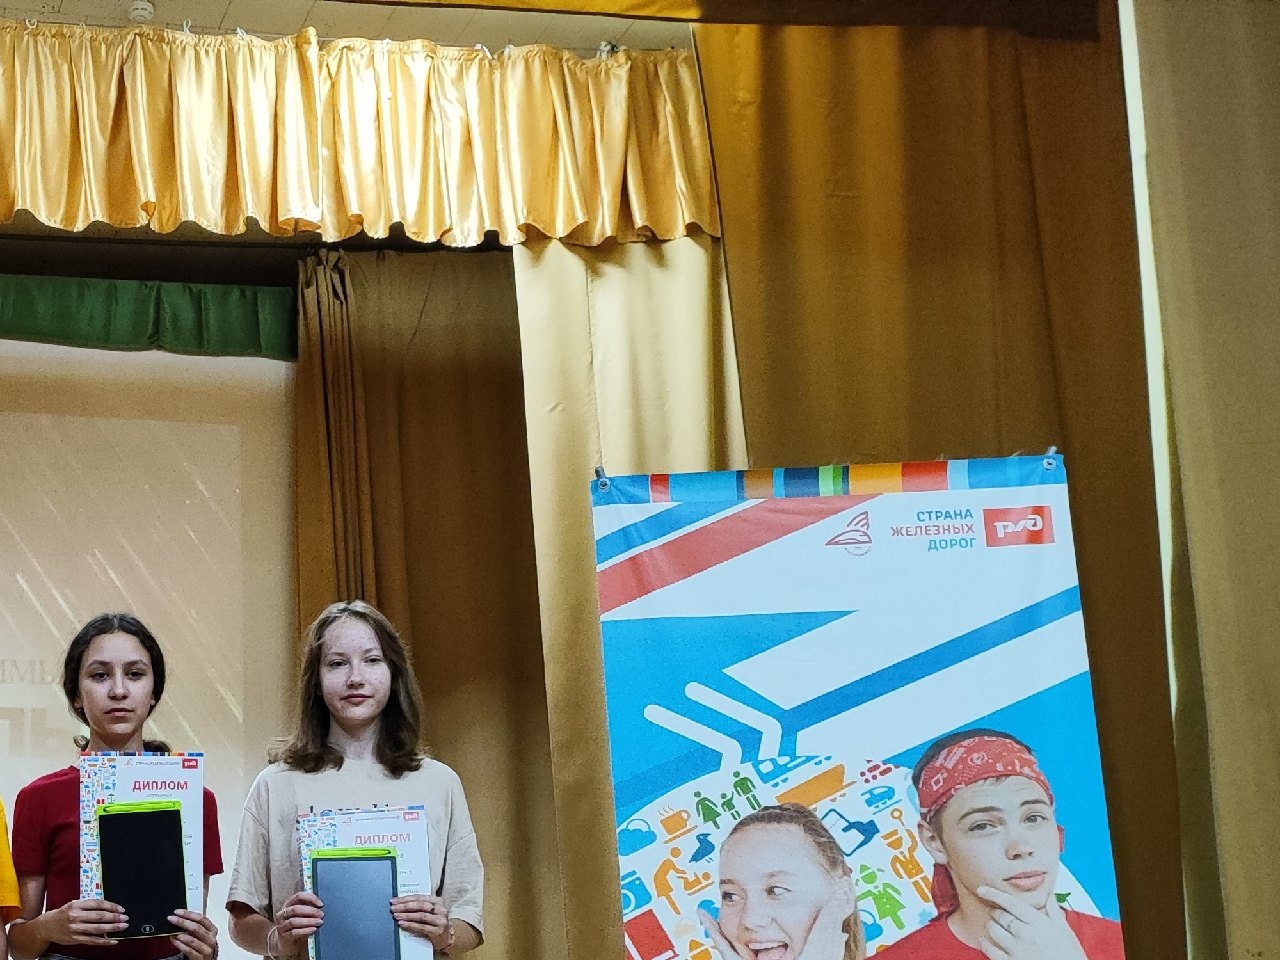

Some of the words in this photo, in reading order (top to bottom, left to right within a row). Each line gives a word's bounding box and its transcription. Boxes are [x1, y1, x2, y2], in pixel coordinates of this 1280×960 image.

[916, 508, 974, 523] СТРАНА
[890, 523, 975, 538] ЖЕЛЕЗНЫХ
[927, 537, 976, 552] ДОРОГ
[132, 780, 188, 793] ДИПЛОМ
[354, 833, 411, 846] ДИПЛОМ
